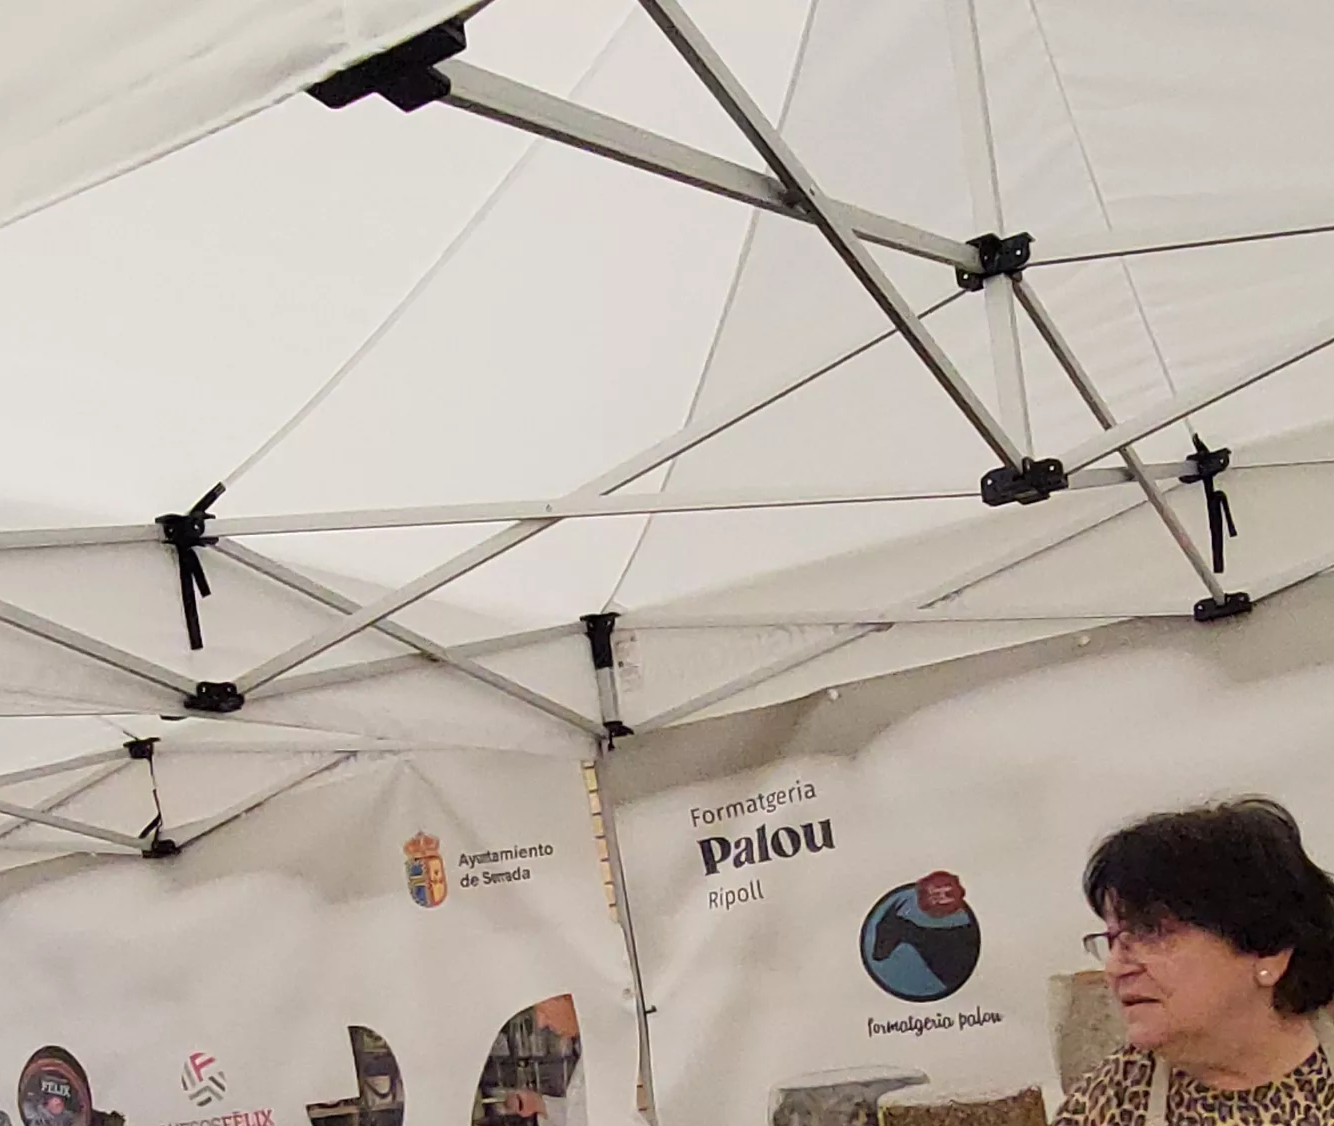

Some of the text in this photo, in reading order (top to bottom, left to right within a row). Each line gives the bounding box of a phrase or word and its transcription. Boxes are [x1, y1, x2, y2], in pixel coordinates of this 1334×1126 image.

[690, 779, 818, 828] Formatgeria
[458, 844, 554, 869] Ayuntamiento
[697, 818, 836, 876] Palou
[460, 873, 479, 888] de
[708, 879, 764, 910] Ripoll
[958, 1005, 1002, 1031] palou
